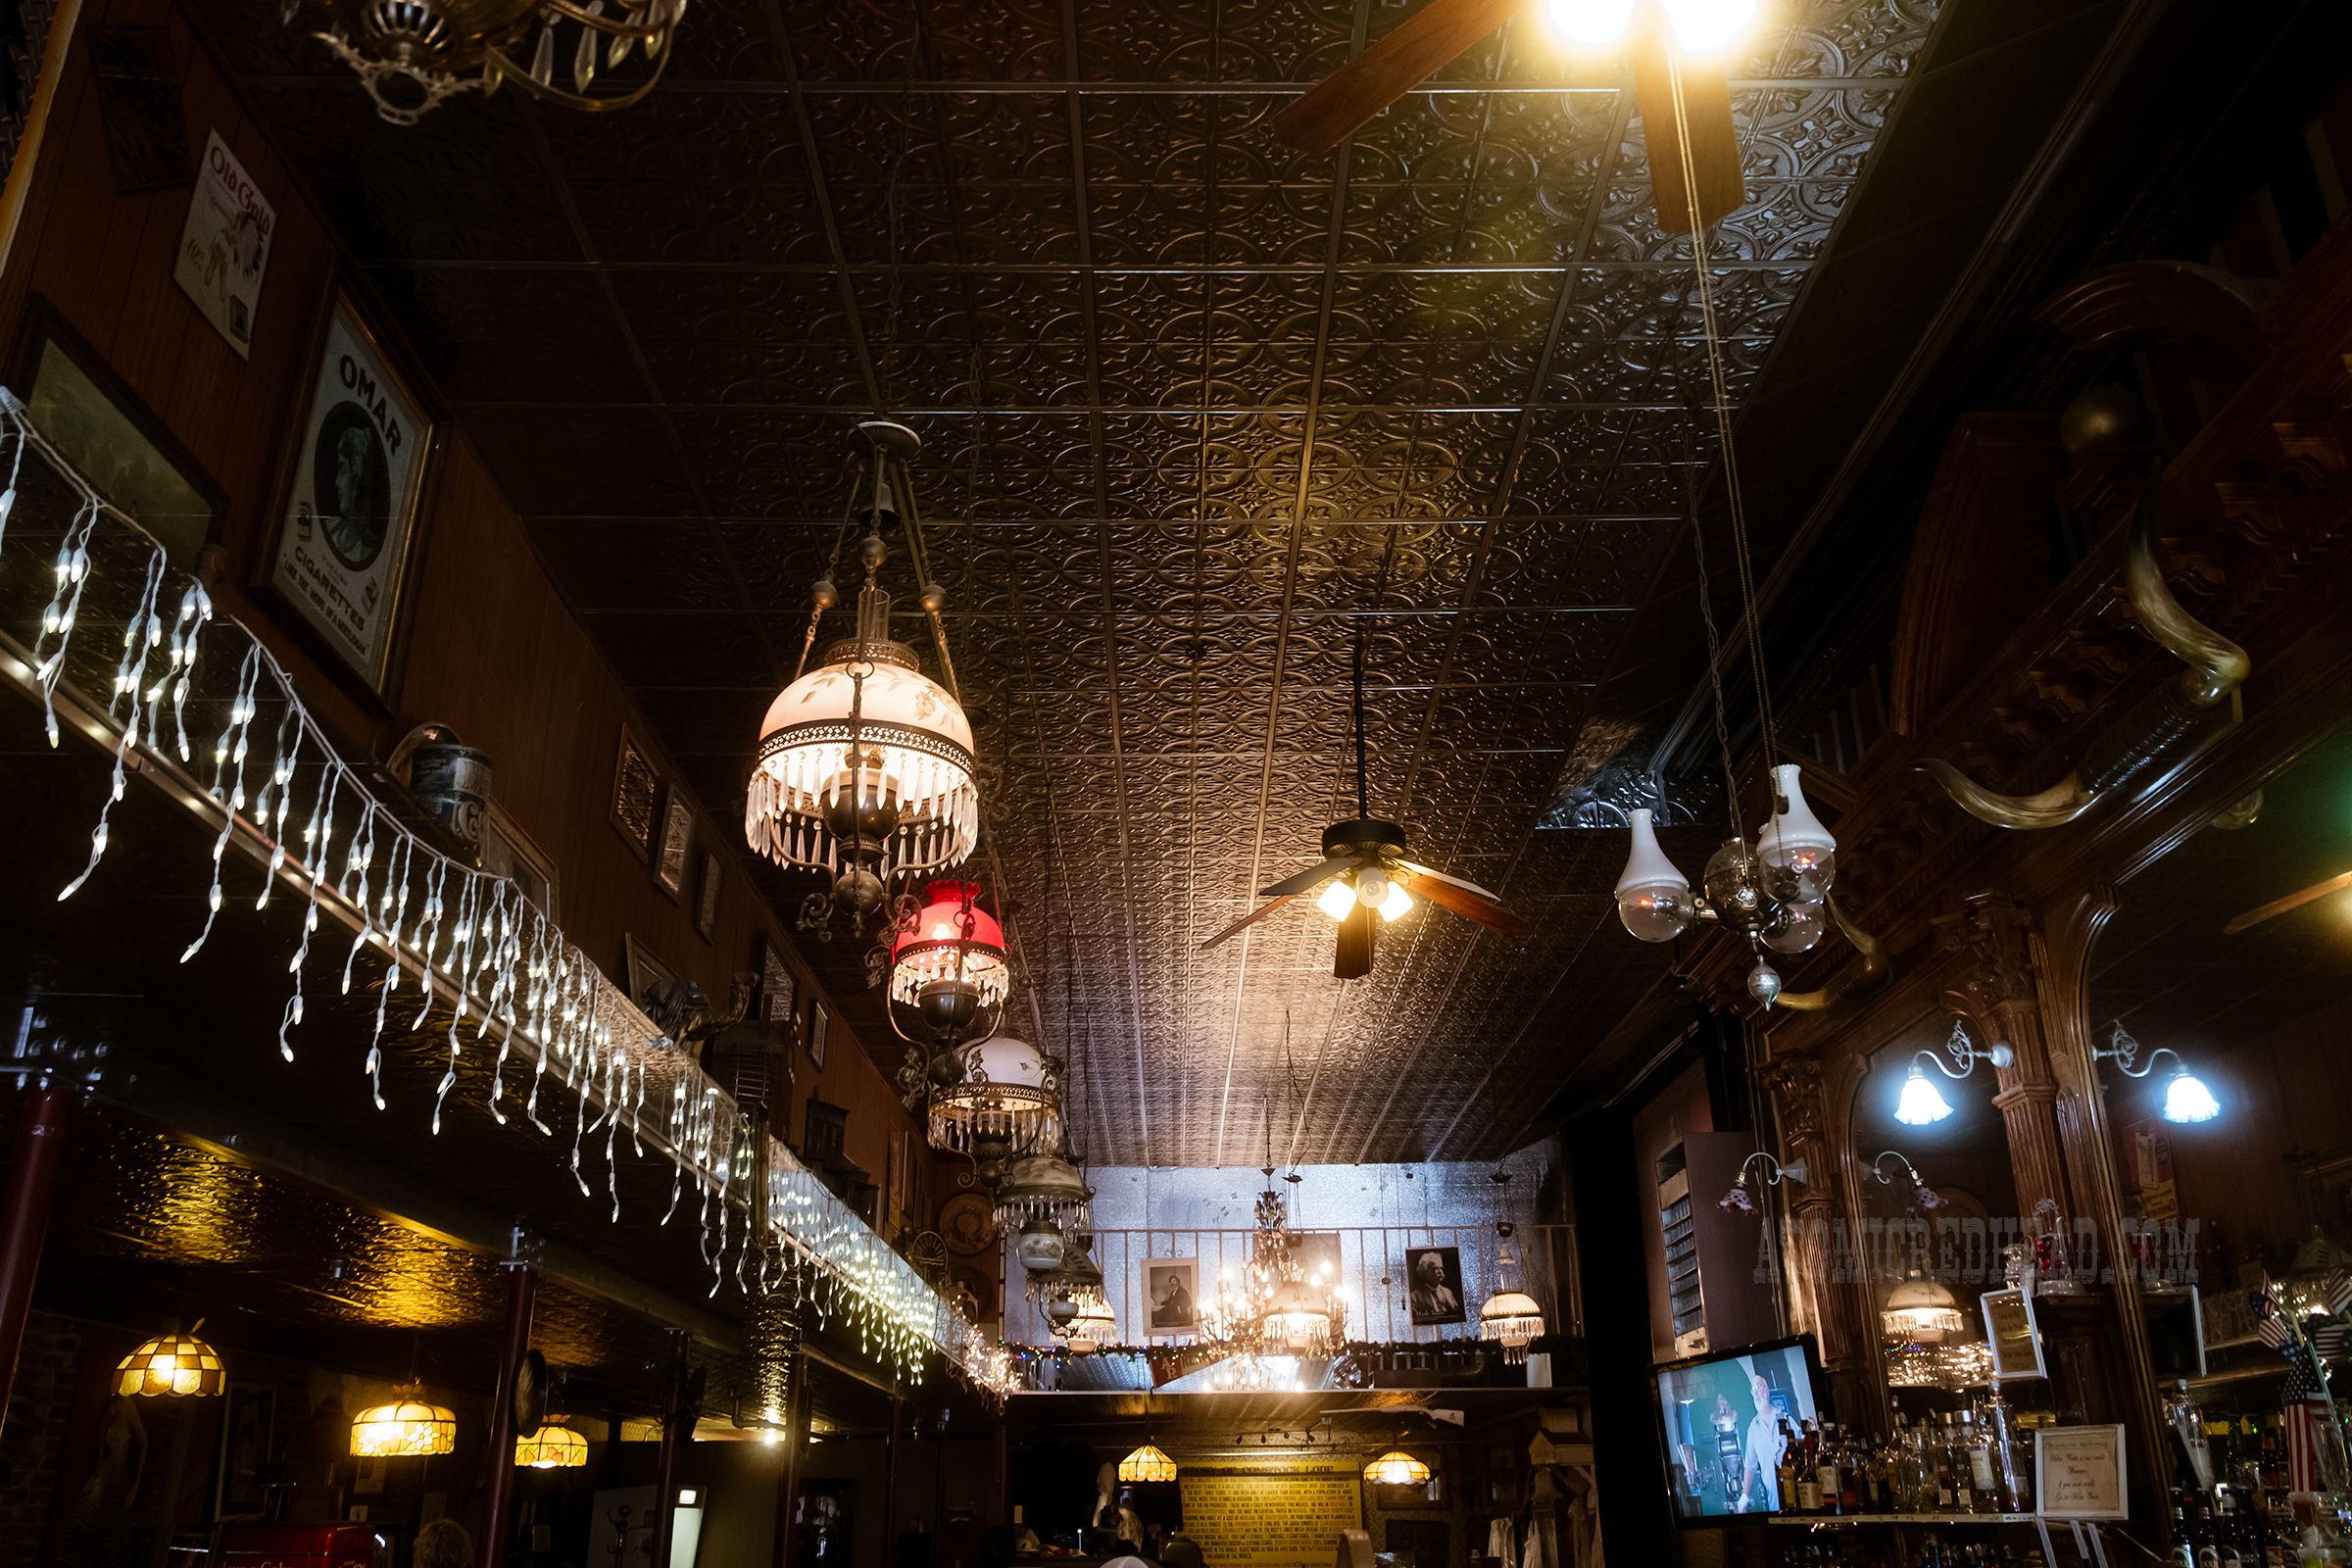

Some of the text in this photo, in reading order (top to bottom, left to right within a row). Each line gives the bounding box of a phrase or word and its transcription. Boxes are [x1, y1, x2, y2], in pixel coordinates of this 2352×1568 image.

[210, 145, 238, 192] Old
[340, 354, 401, 458] OMAR
[295, 546, 365, 632] CIGARETTES
